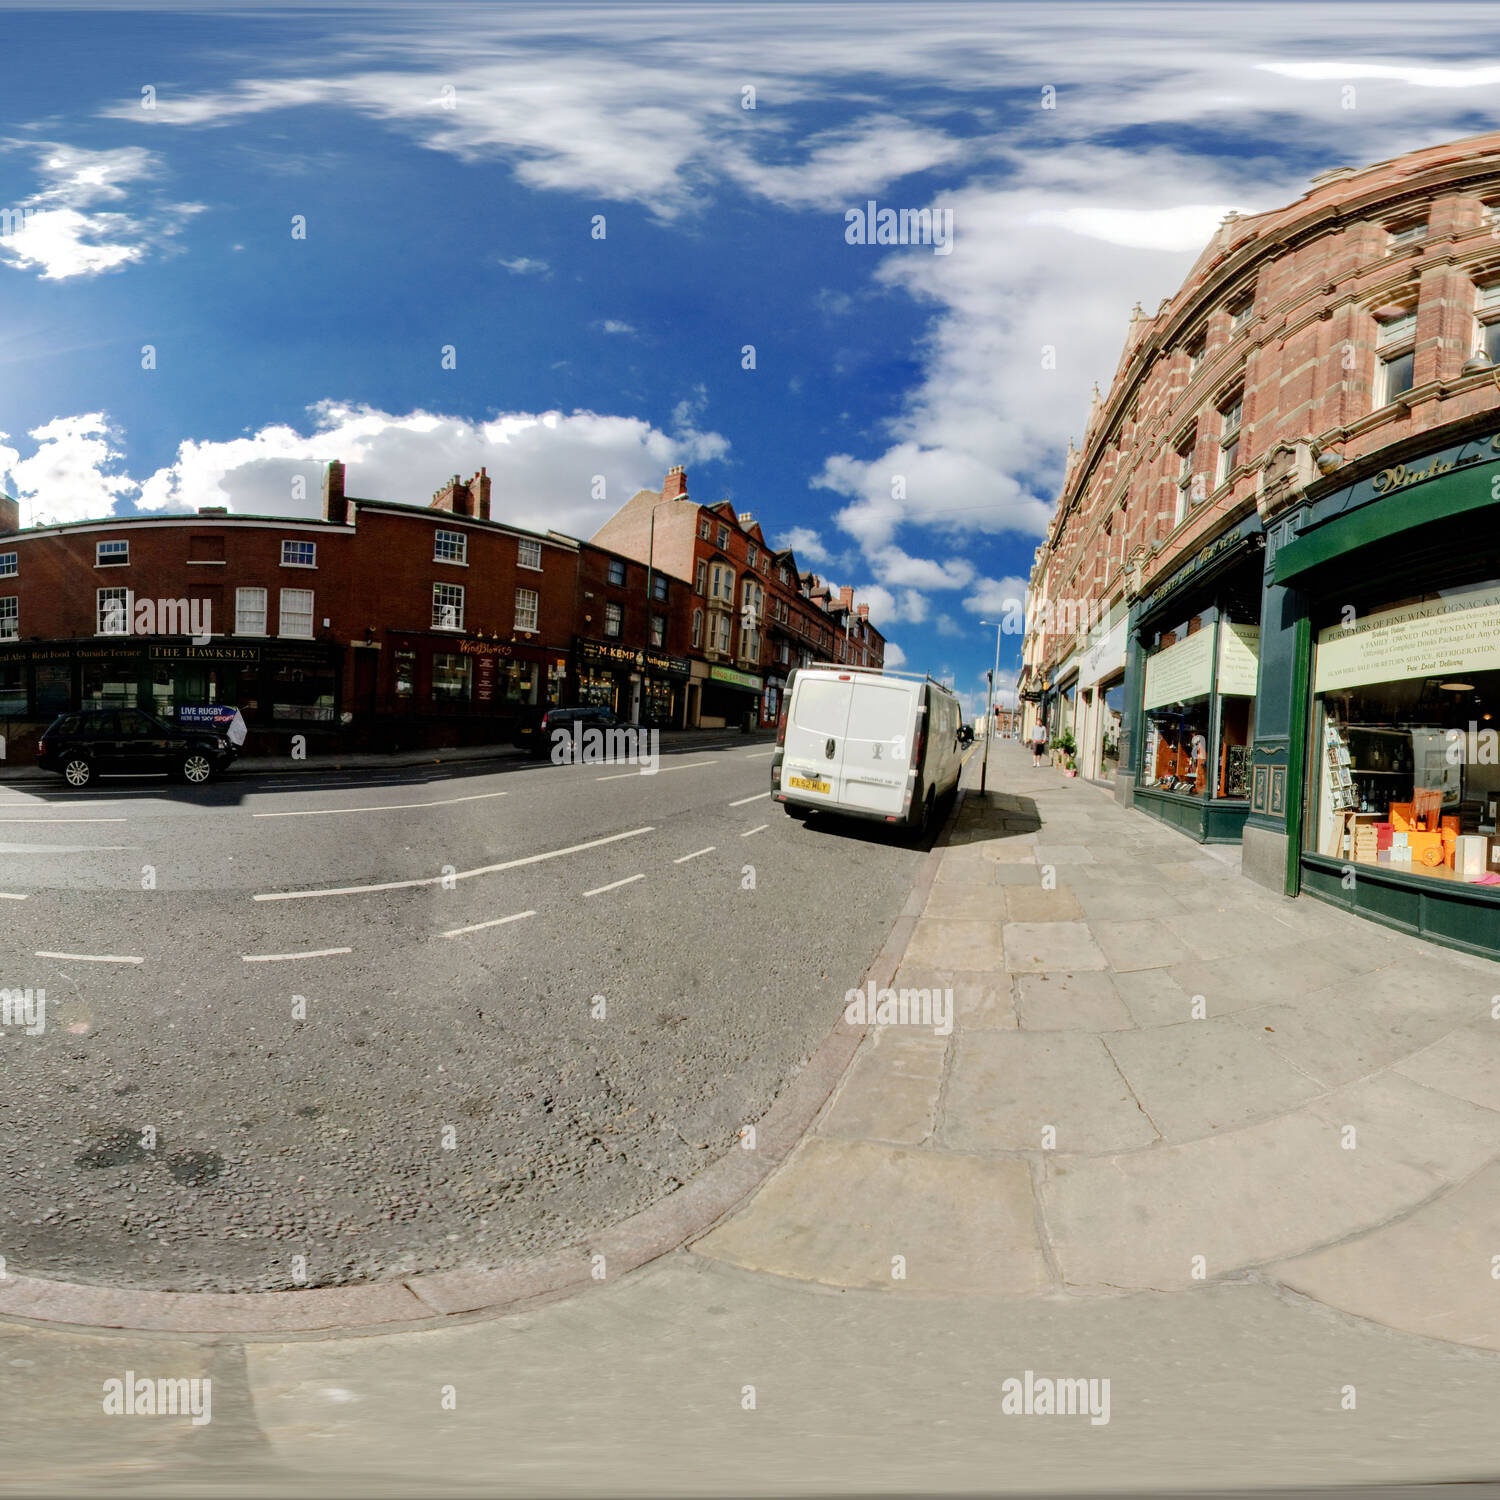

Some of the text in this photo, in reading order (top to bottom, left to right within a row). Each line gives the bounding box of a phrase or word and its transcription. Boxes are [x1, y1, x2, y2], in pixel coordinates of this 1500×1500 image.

[1328, 623, 1372, 641] PURVEYORS
[1372, 619, 1385, 630] OF
[1386, 615, 1407, 627] FINE
[1407, 609, 1435, 622] WINE,
[1436, 599, 1482, 616] COGNAC
[1482, 598, 1490, 607] &
[1365, 638, 1389, 650] FAMILY
[1392, 632, 1418, 645] OWNED
[1421, 621, 1479, 639] INDEPENDANT
[1417, 639, 1438, 650] Drinks
[1438, 634, 1465, 648] Package
[1465, 630, 1477, 639] for
[1477, 629, 1493, 640] Any
[32, 652, 48, 660] Real
[50, 651, 70, 659] Food
[154, 647, 180, 657] THE
[186, 647, 256, 659] HAWKSLEY
[180, 707, 223, 715] LIVE RUGBY
